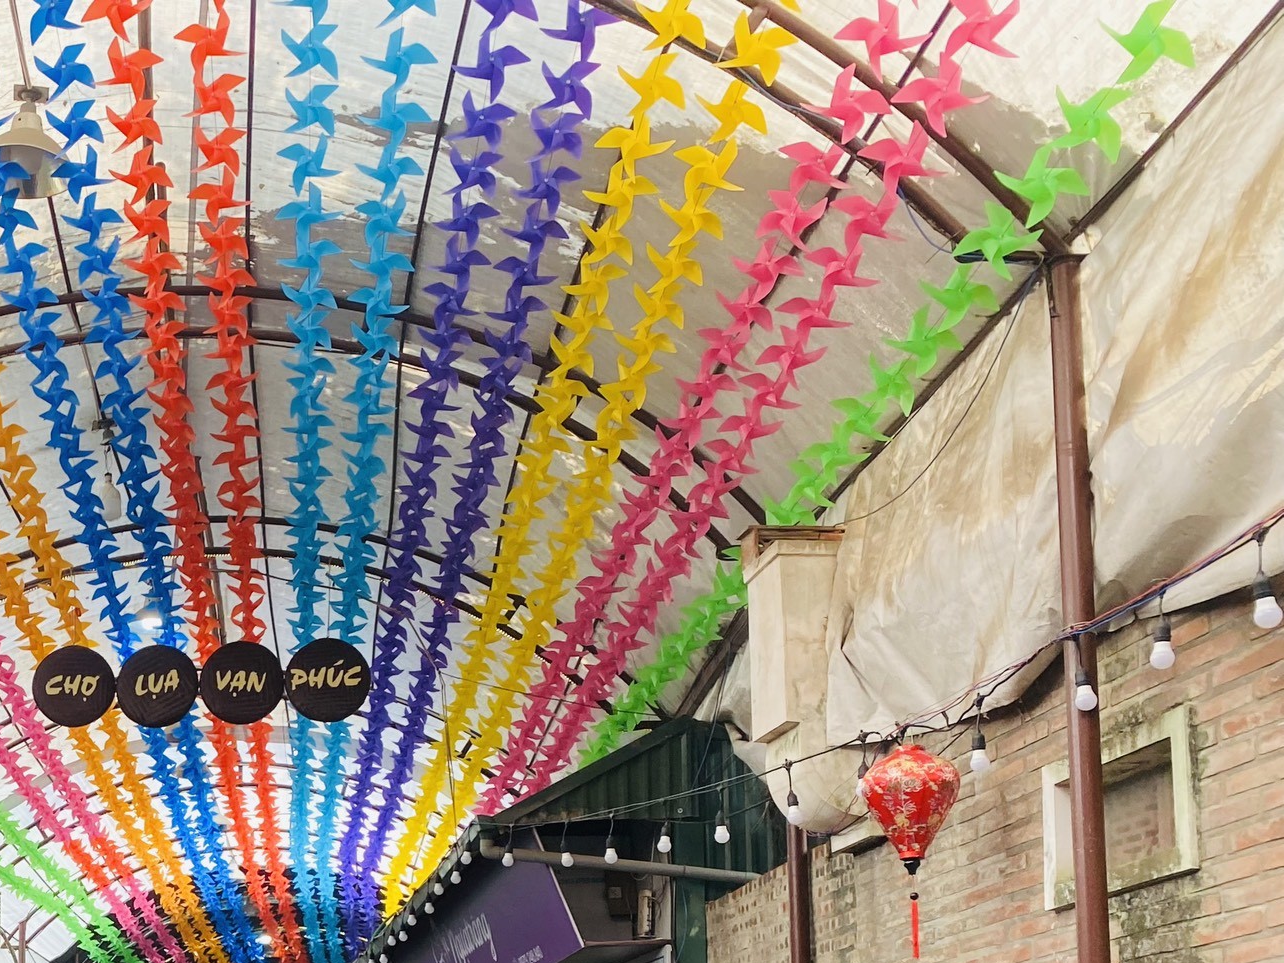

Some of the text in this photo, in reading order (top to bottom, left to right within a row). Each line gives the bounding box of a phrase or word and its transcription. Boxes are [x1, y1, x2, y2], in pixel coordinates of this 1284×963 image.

[45, 660, 362, 703] CHỢ LỤA VẠN PHÚC
